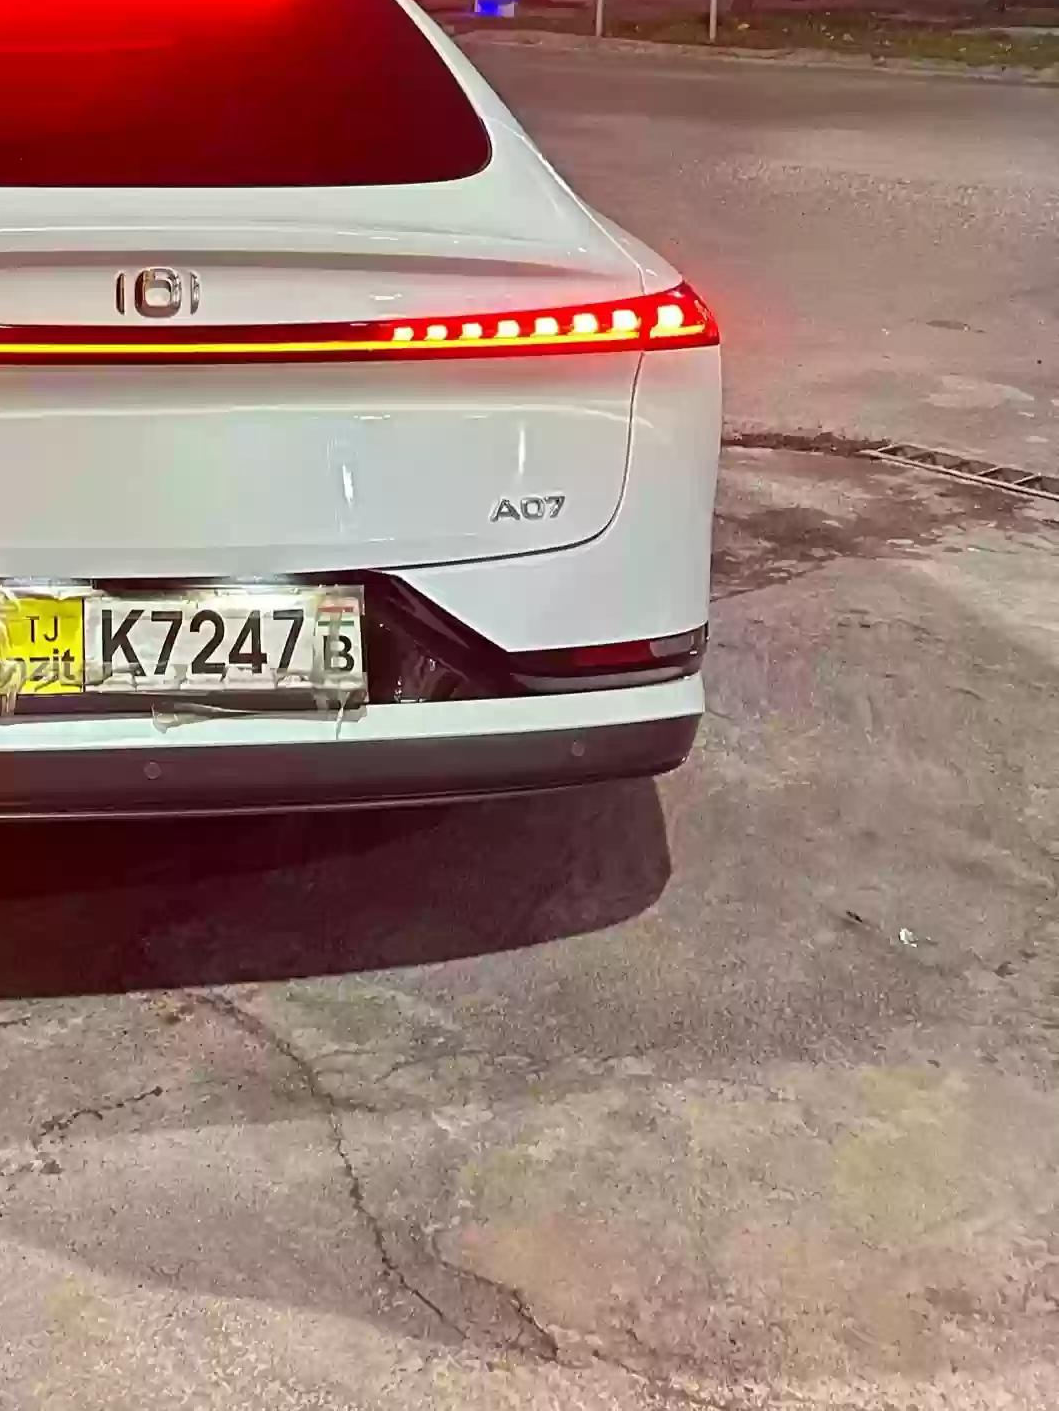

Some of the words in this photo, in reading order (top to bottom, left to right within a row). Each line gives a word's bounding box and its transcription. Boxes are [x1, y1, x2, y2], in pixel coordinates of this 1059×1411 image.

[489, 495, 566, 523] A07
[25, 615, 59, 645] TJ
[100, 607, 305, 678] K7247
[322, 634, 356, 673] B
